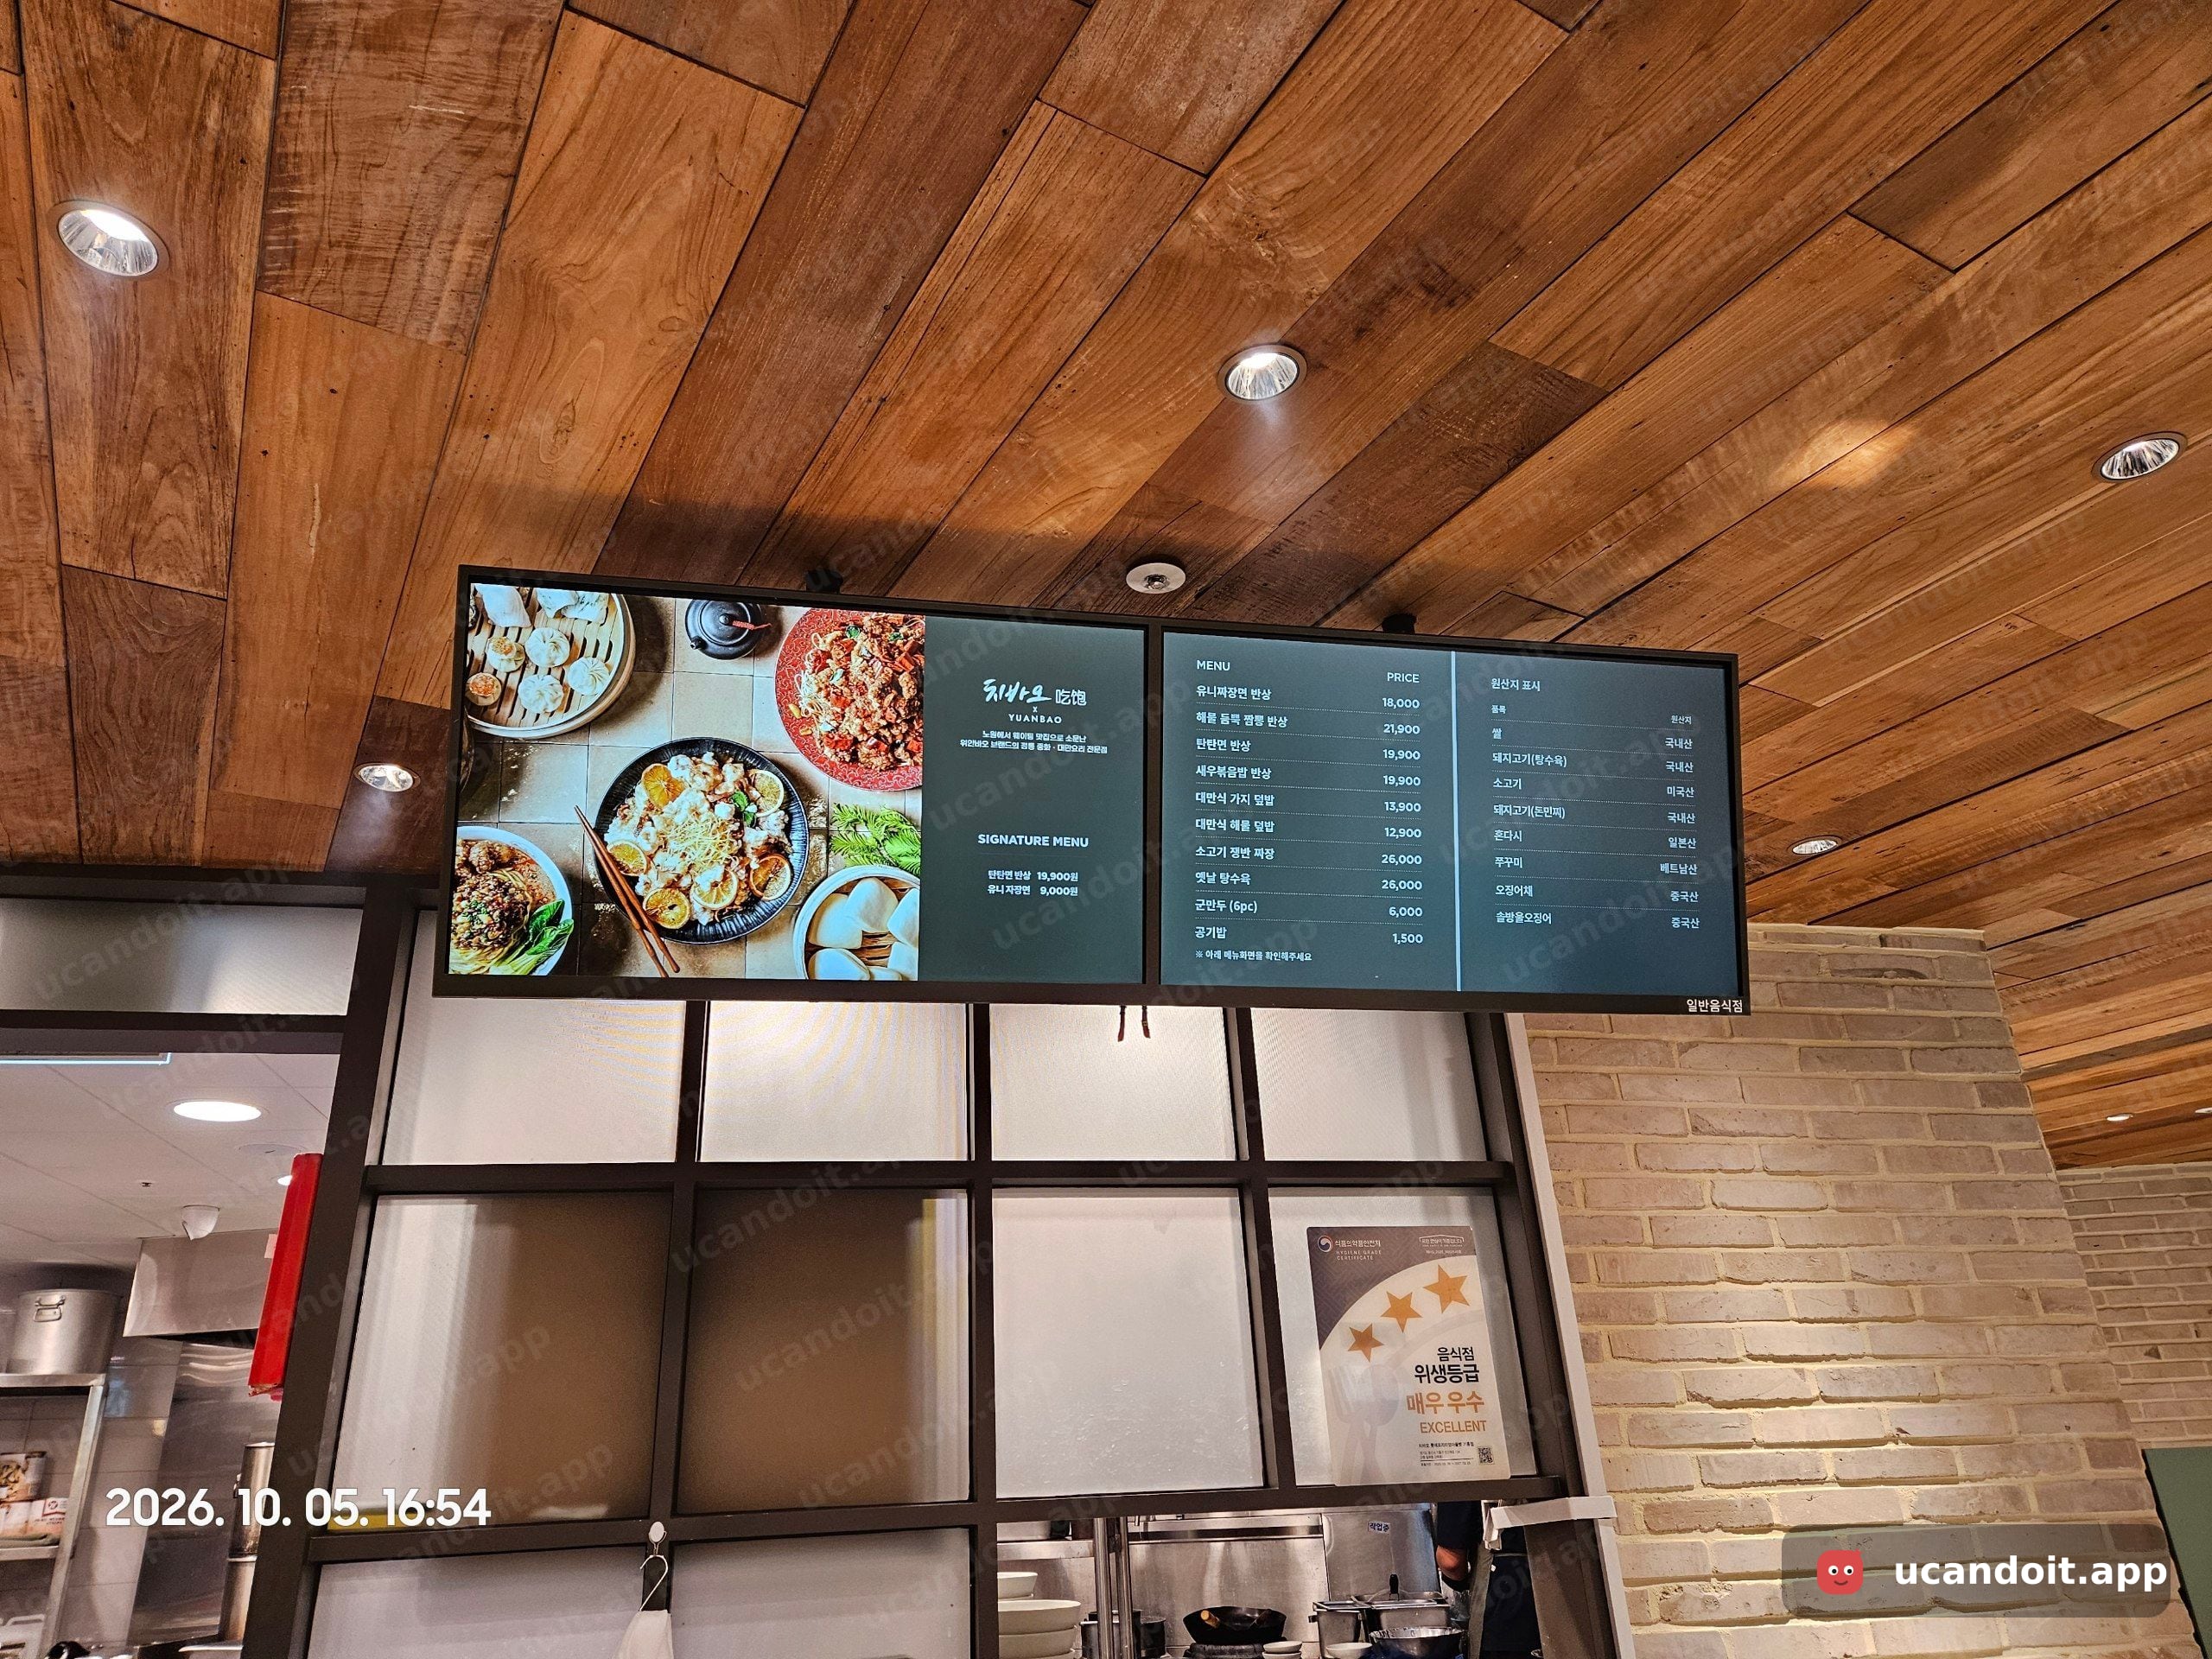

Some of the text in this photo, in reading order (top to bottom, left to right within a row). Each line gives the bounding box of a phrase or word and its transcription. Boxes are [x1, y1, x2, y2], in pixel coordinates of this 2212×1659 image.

[1197, 660, 1230, 671] MENU
[1388, 672, 1419, 683] PRICE
[1491, 678, 1540, 691] 원산지 표시
[1056, 689, 1086, 705] 吃饱
[1197, 685, 1271, 700] 유니짜장면 반상
[1382, 698, 1420, 709] 18,000
[1008, 714, 1062, 723] YUANBAO
[1197, 712, 1287, 728] 해물 듬뿍 짬뽕 반상
[1671, 715, 1691, 724] 원산지
[1383, 724, 1420, 734] 21,900
[1492, 728, 1502, 739] 쌀
[1197, 738, 1251, 752] 탄탄면 반상
[1665, 738, 1693, 749] 국내산
[1383, 749, 1421, 760] 19,900
[1492, 752, 1567, 767] 돼지고기(탕수육)
[1196, 765, 1271, 779] 새우볶음밥 반상
[1666, 761, 1694, 772] 국내산
[1383, 775, 1421, 786] 19,900
[1493, 778, 1522, 789] 소고기
[1667, 786, 1694, 798] 미국산
[1196, 792, 1274, 806] 대만식 가지 덮밥
[1384, 802, 1421, 813] 13,900
[1668, 812, 1695, 823] 국내산
[1196, 818, 1274, 832] 대만식 해물 덮밥
[1385, 828, 1421, 839] 12,900
[1494, 830, 1522, 842] 혼다시
[978, 834, 1088, 847] SIGNATURE MENU
[1669, 837, 1696, 849] 일본산
[1196, 846, 1274, 860] 소고기 쟁반 짜장
[1382, 855, 1421, 865] 26,000
[1495, 857, 1522, 868] 쭈꾸미
[1660, 863, 1697, 874] 베트남산
[988, 870, 1078, 881] 탄탄면 반상 19,900원
[1196, 872, 1250, 885] 옛날 탕수육
[988, 885, 1078, 896] 유니 자장면 9,000원
[1382, 880, 1422, 891] 26,000
[1496, 885, 1533, 897] 오징어채
[1670, 891, 1699, 902] 중국산
[1195, 899, 1257, 913] 군만두 (6pc)
[1389, 906, 1422, 918] 6,000
[1496, 912, 1551, 924] 솔방울오징어
[1672, 918, 1700, 928] 중국산
[1195, 926, 1227, 938] 공기밥
[1393, 933, 1423, 944] 1,500
[1205, 950, 1221, 959] 아래
[1224, 950, 1262, 960] 메뉴화면을
[1265, 951, 1312, 961] 확인해주세요
[1687, 999, 1742, 1013] 일반음식점
[1437, 1347, 1474, 1362] 음식점
[1414, 1364, 1479, 1383] 위생등급
[1407, 1391, 1484, 1414] 매우 우수
[1421, 1421, 1486, 1433] EXCELLENT
